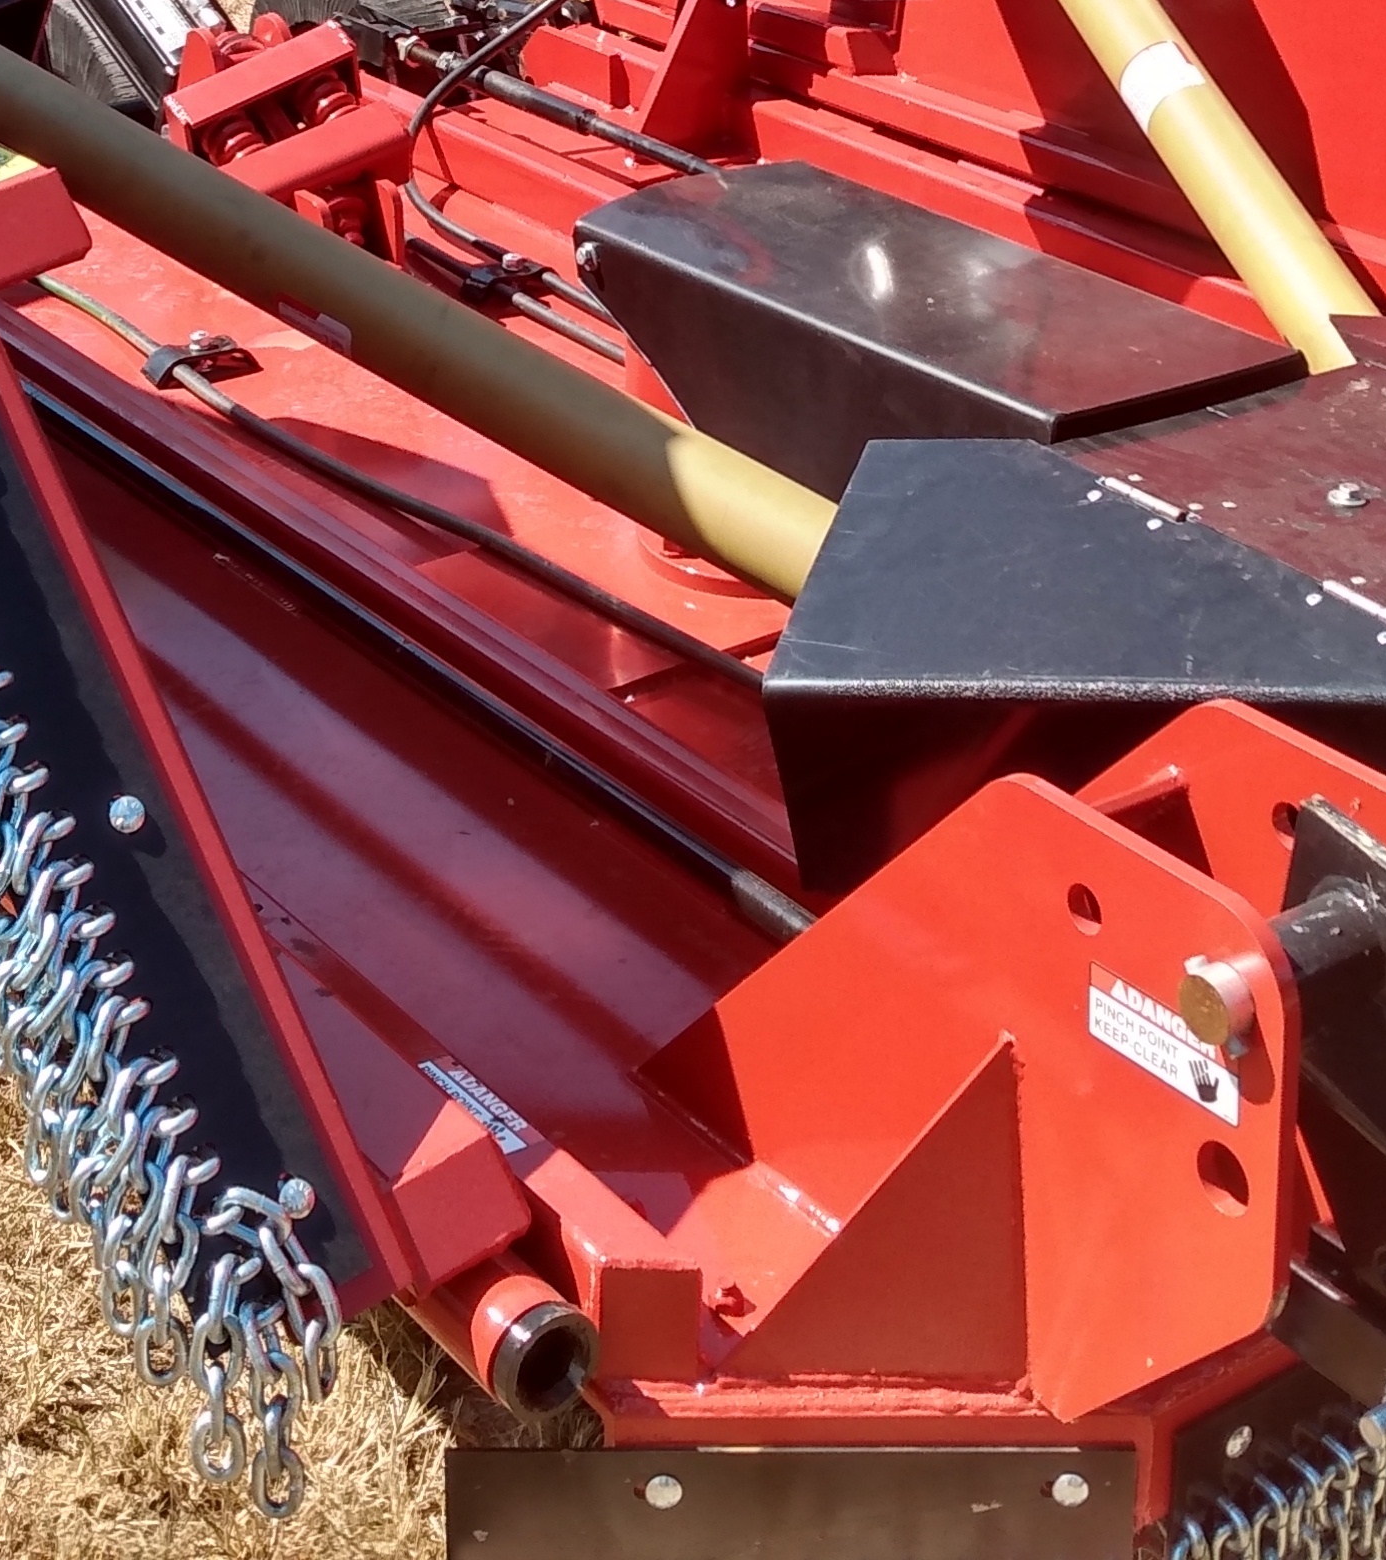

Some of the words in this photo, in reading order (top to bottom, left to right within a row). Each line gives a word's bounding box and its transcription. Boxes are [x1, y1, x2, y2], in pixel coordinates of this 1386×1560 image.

[1095, 997, 1134, 1032] PINCH
[1139, 1025, 1179, 1058] POINT
[459, 1076, 528, 1132] DANGER
